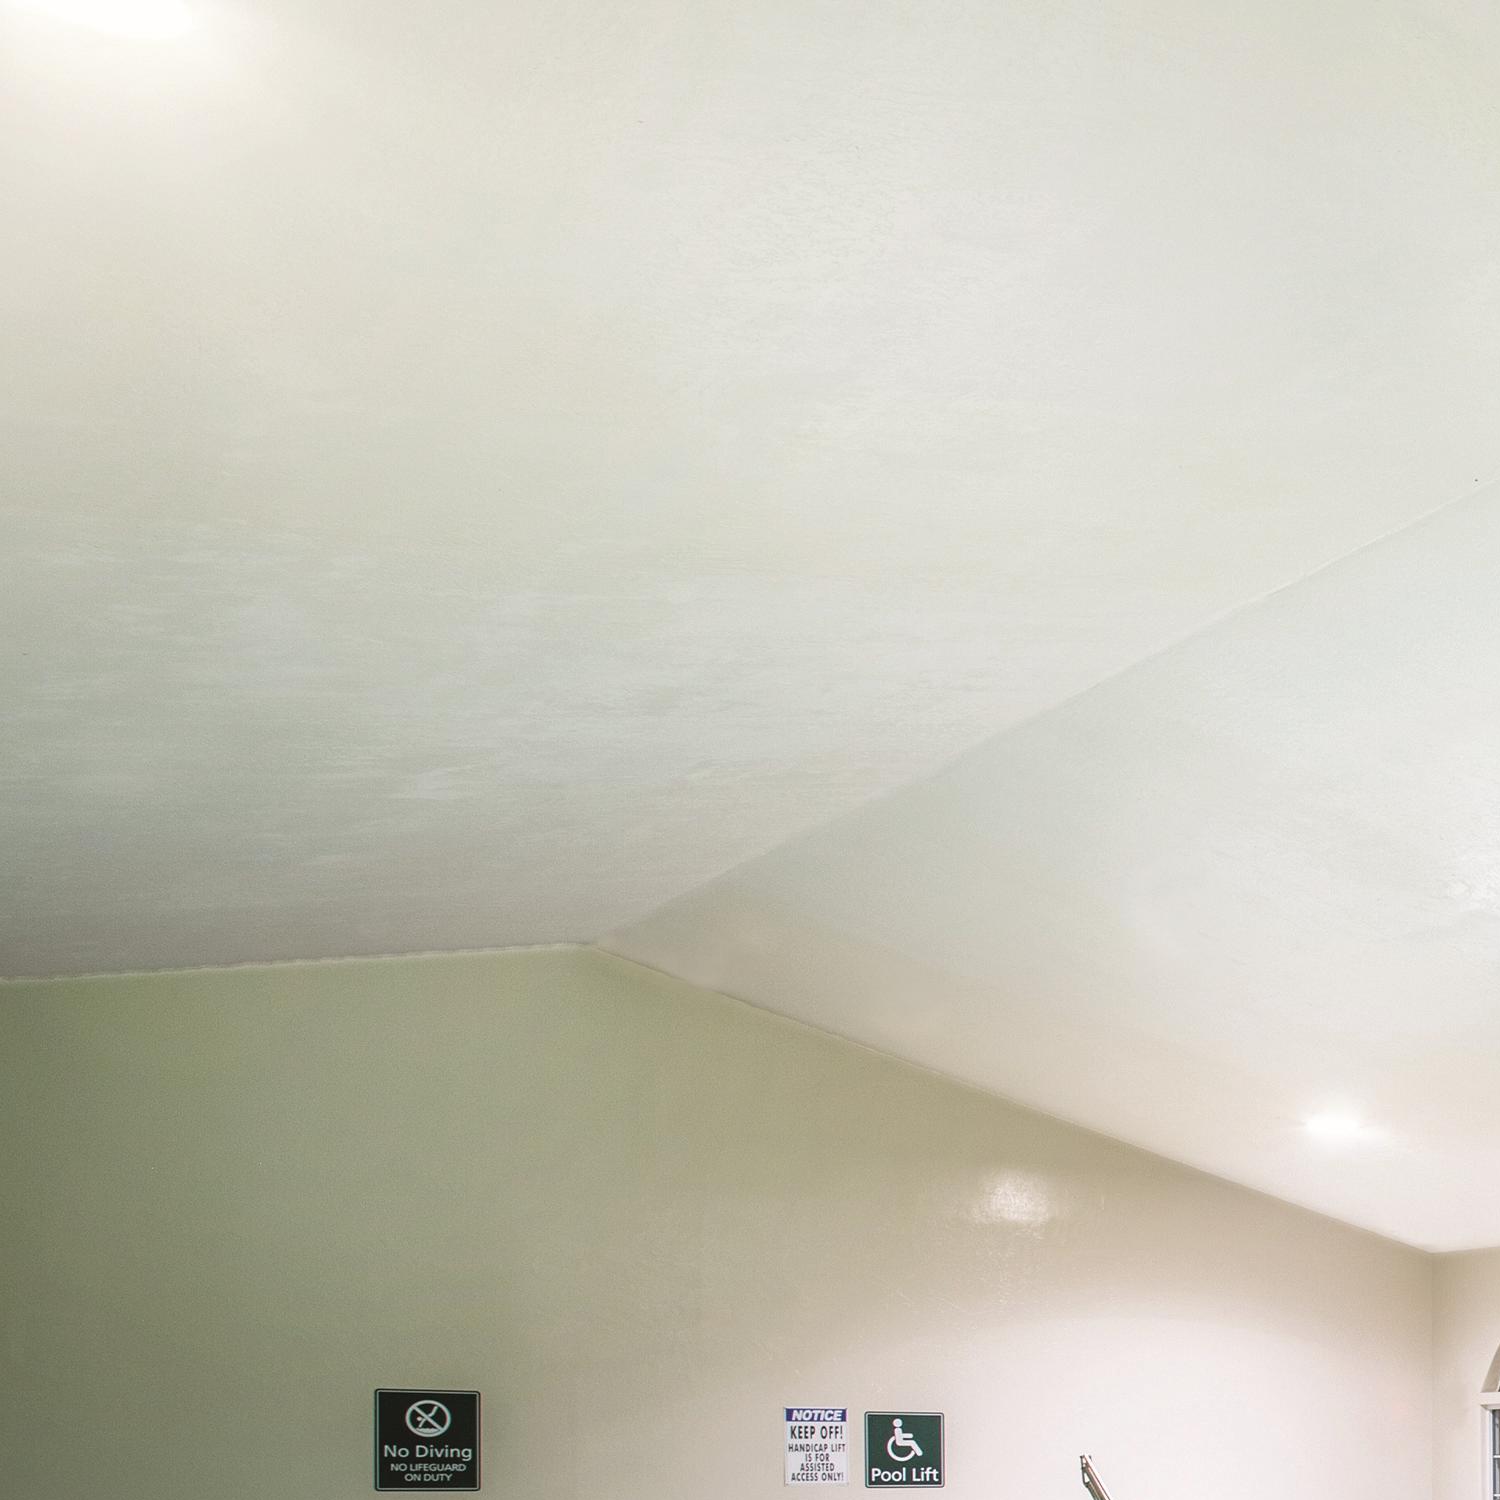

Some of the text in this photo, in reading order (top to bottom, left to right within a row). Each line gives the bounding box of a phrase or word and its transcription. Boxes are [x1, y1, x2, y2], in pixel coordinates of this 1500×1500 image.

[792, 1410, 842, 1421] NOTICE
[790, 1425, 843, 1439] KEEP OFF!
[788, 1443, 846, 1452] HANDICAP LIFT
[384, 1444, 472, 1461] No Diving
[805, 1453, 830, 1462] IS FOR
[390, 1463, 466, 1472] NO LIFEGUARD
[800, 1463, 835, 1471] ASSISTED
[404, 1473, 453, 1481] ON DUTY
[791, 1473, 844, 1481] ACCESS ONLY!
[871, 1467, 939, 1482] Pool Lift
